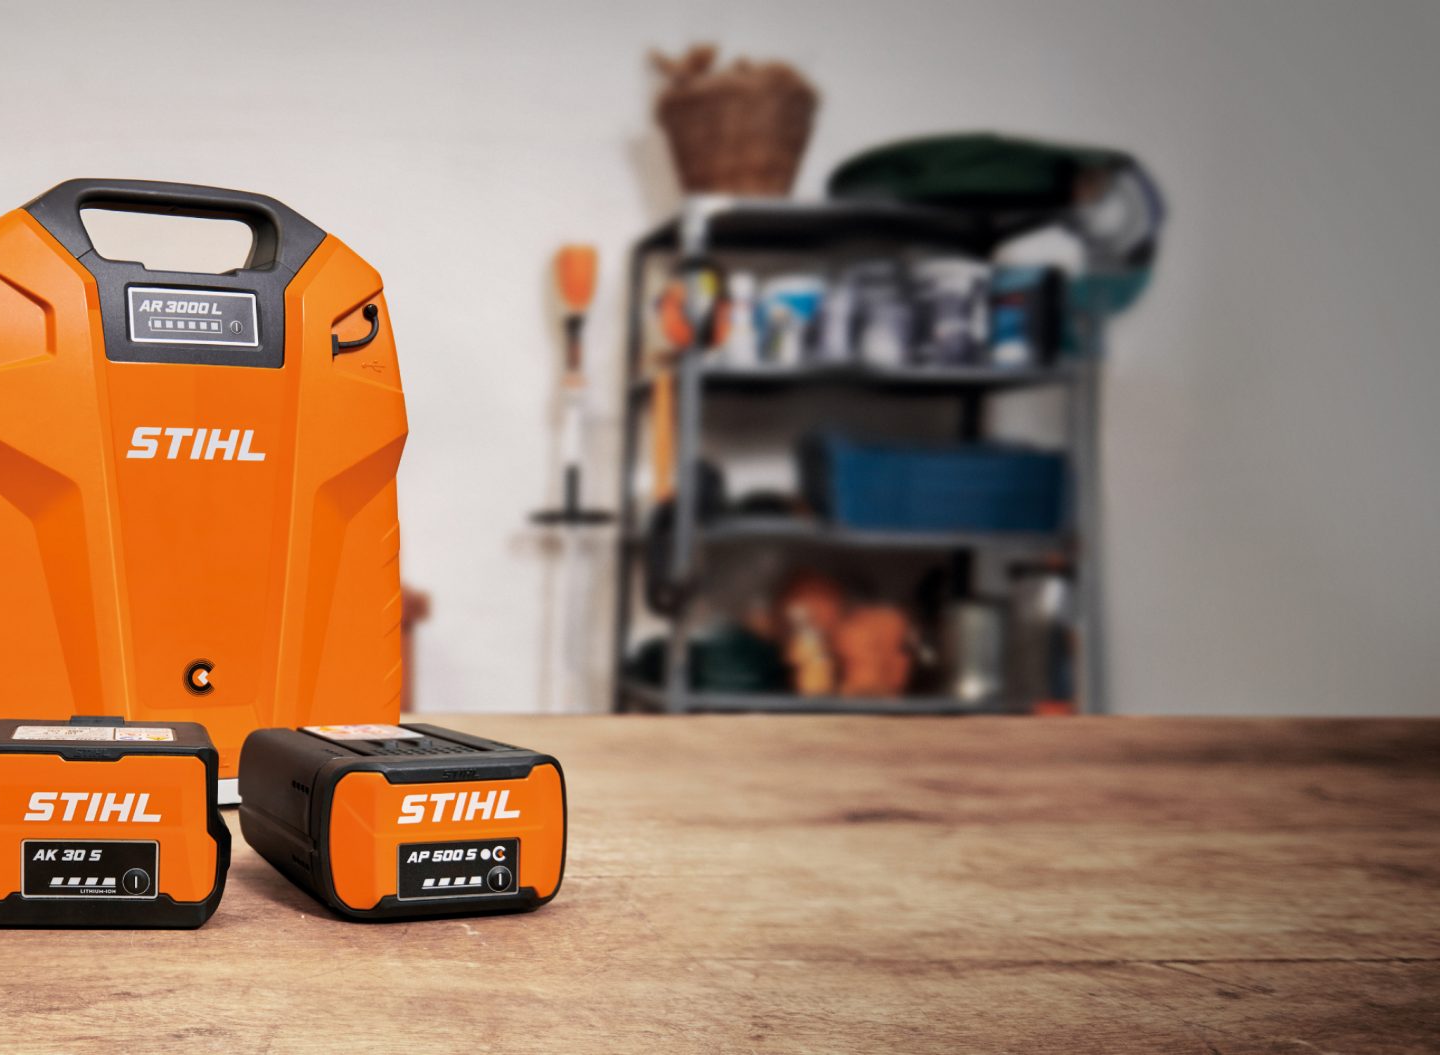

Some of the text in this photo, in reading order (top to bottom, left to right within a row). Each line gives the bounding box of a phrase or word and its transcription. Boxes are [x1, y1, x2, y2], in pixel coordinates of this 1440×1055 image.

[139, 300, 222, 315] AR 3000 L
[126, 427, 266, 461] STIHL
[24, 792, 161, 822] STIHL
[397, 790, 521, 825] STIHL
[33, 849, 102, 861] AK 30 S
[407, 849, 477, 863] AP 500 S
